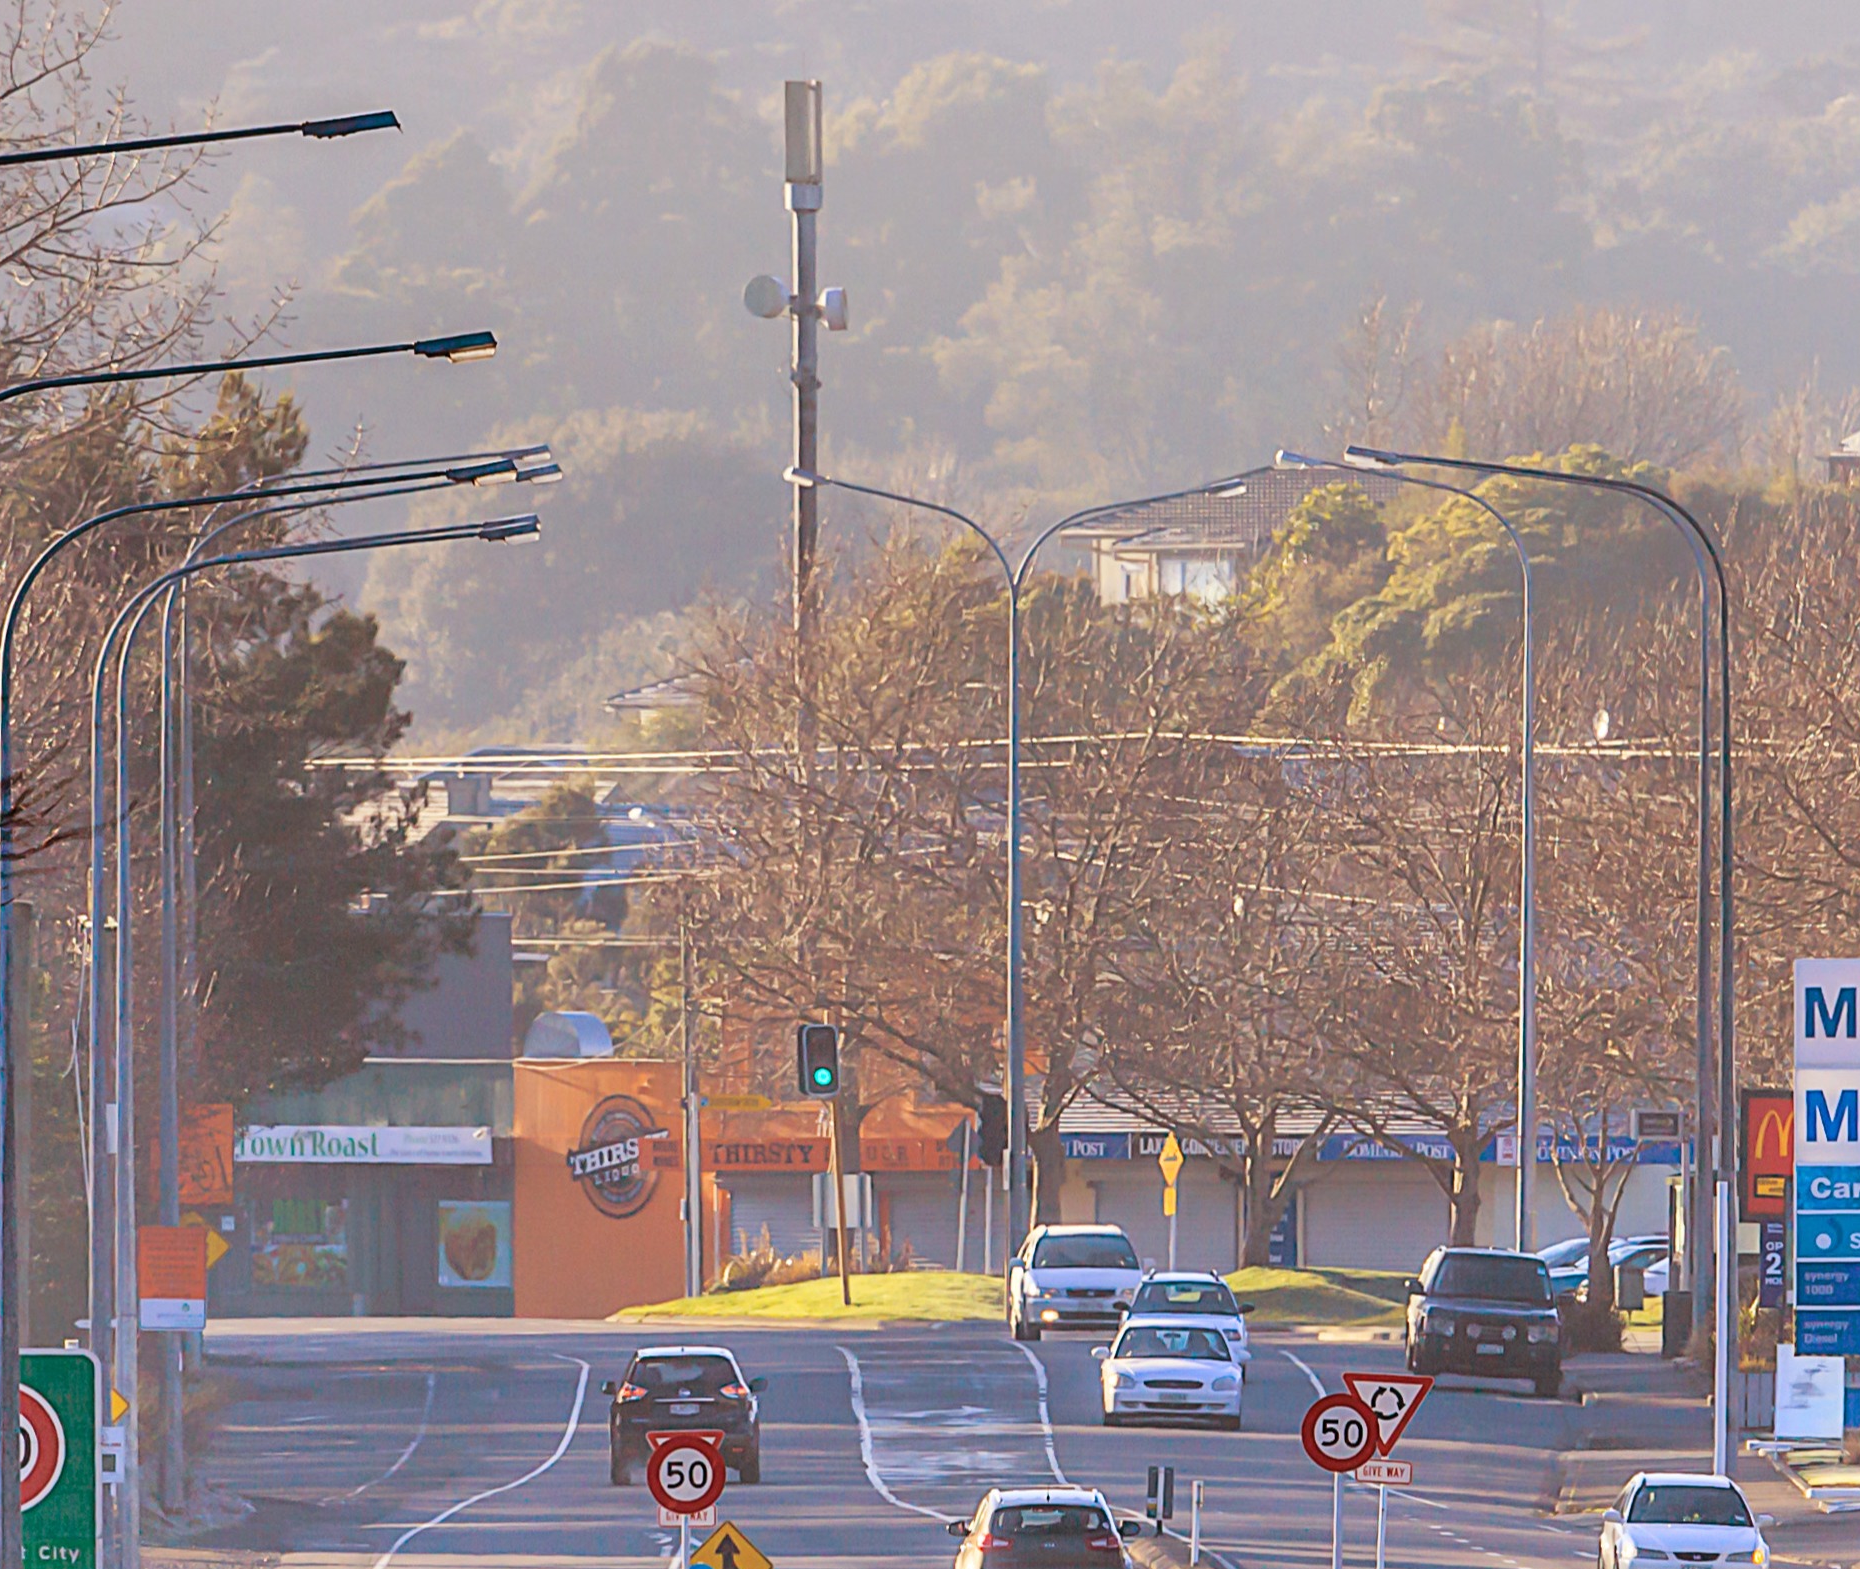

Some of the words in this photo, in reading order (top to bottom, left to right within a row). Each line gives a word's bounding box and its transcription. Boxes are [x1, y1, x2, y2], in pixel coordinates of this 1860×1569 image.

[309, 1130, 379, 1157] Roast
[1072, 1137, 1106, 1156] POST
[1416, 1140, 1450, 1158] POST
[712, 1144, 814, 1165] THIRSTY
[594, 1163, 640, 1185] LIQUO
[1321, 1419, 1364, 1448] 50
[666, 1460, 708, 1489] 50
[1362, 1465, 1383, 1478] GIVE
[1386, 1466, 1406, 1479] WAY
[39, 1545, 80, 1563] City
